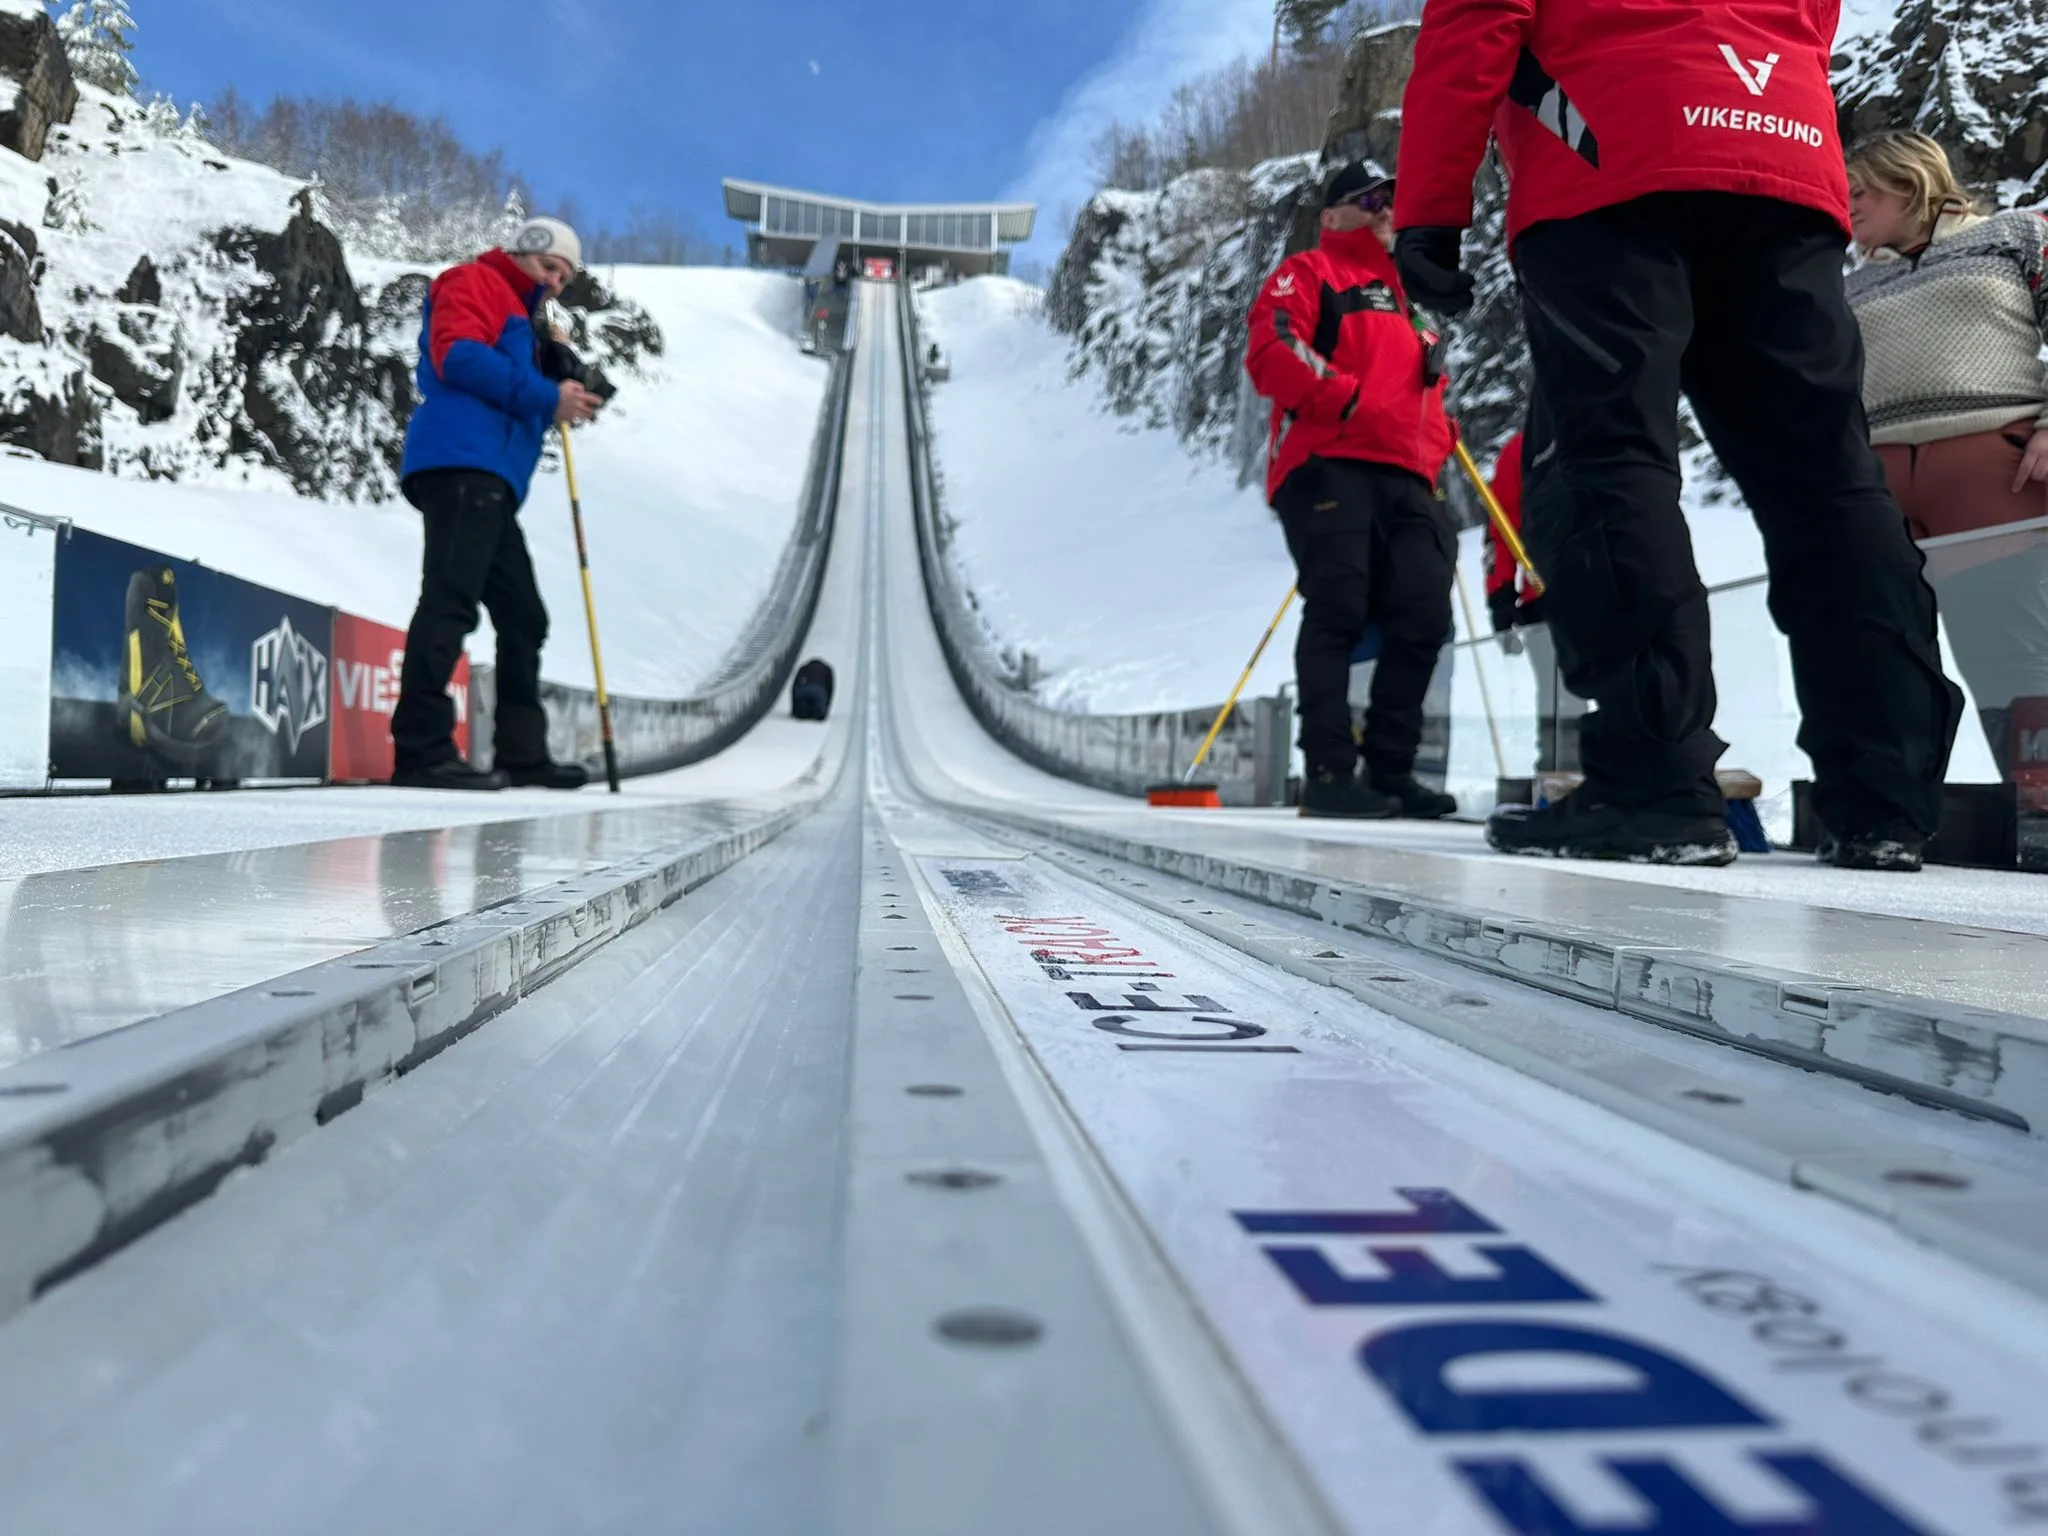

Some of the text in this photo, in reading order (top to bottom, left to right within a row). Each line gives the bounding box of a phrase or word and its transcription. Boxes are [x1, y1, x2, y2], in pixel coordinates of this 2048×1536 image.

[1682, 106, 1823, 148] VIKERSUND
[993, 914, 1302, 1053] ICE-TRACK
[1645, 1262, 2048, 1526] nology
